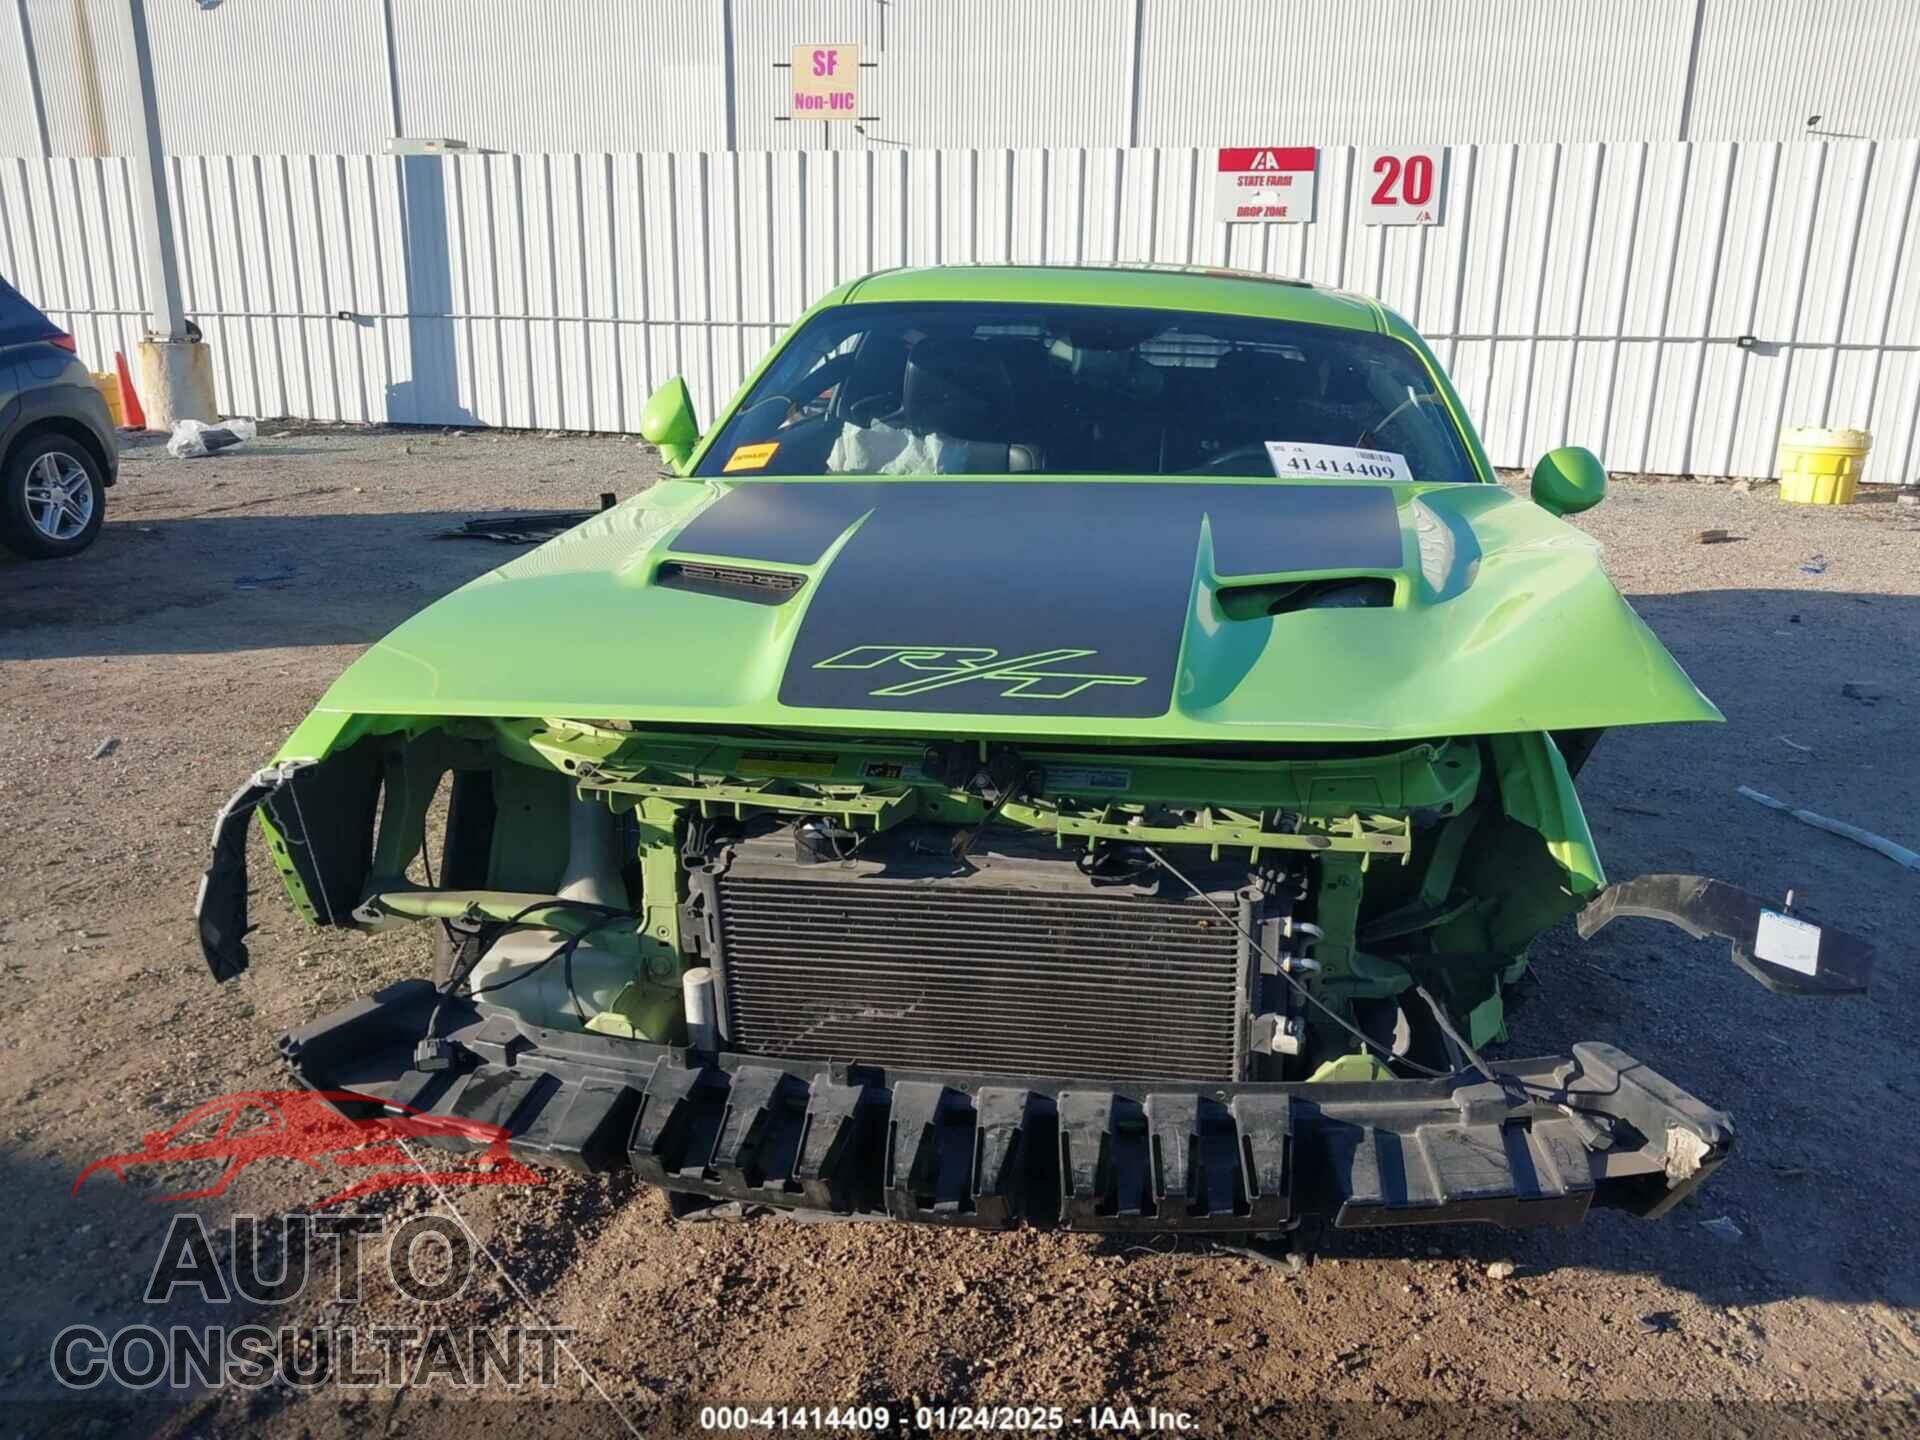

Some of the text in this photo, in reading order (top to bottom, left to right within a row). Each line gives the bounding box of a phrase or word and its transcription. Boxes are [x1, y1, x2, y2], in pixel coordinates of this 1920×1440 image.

[812, 49, 838, 77] SF
[794, 92, 855, 110] Non-VIC
[1237, 175, 1293, 187] STATE FARM
[1370, 154, 1433, 206] 20
[1236, 206, 1288, 217] DROP ZONE
[1287, 457, 1395, 480] 41414409
[811, 646, 1147, 699] R/T
